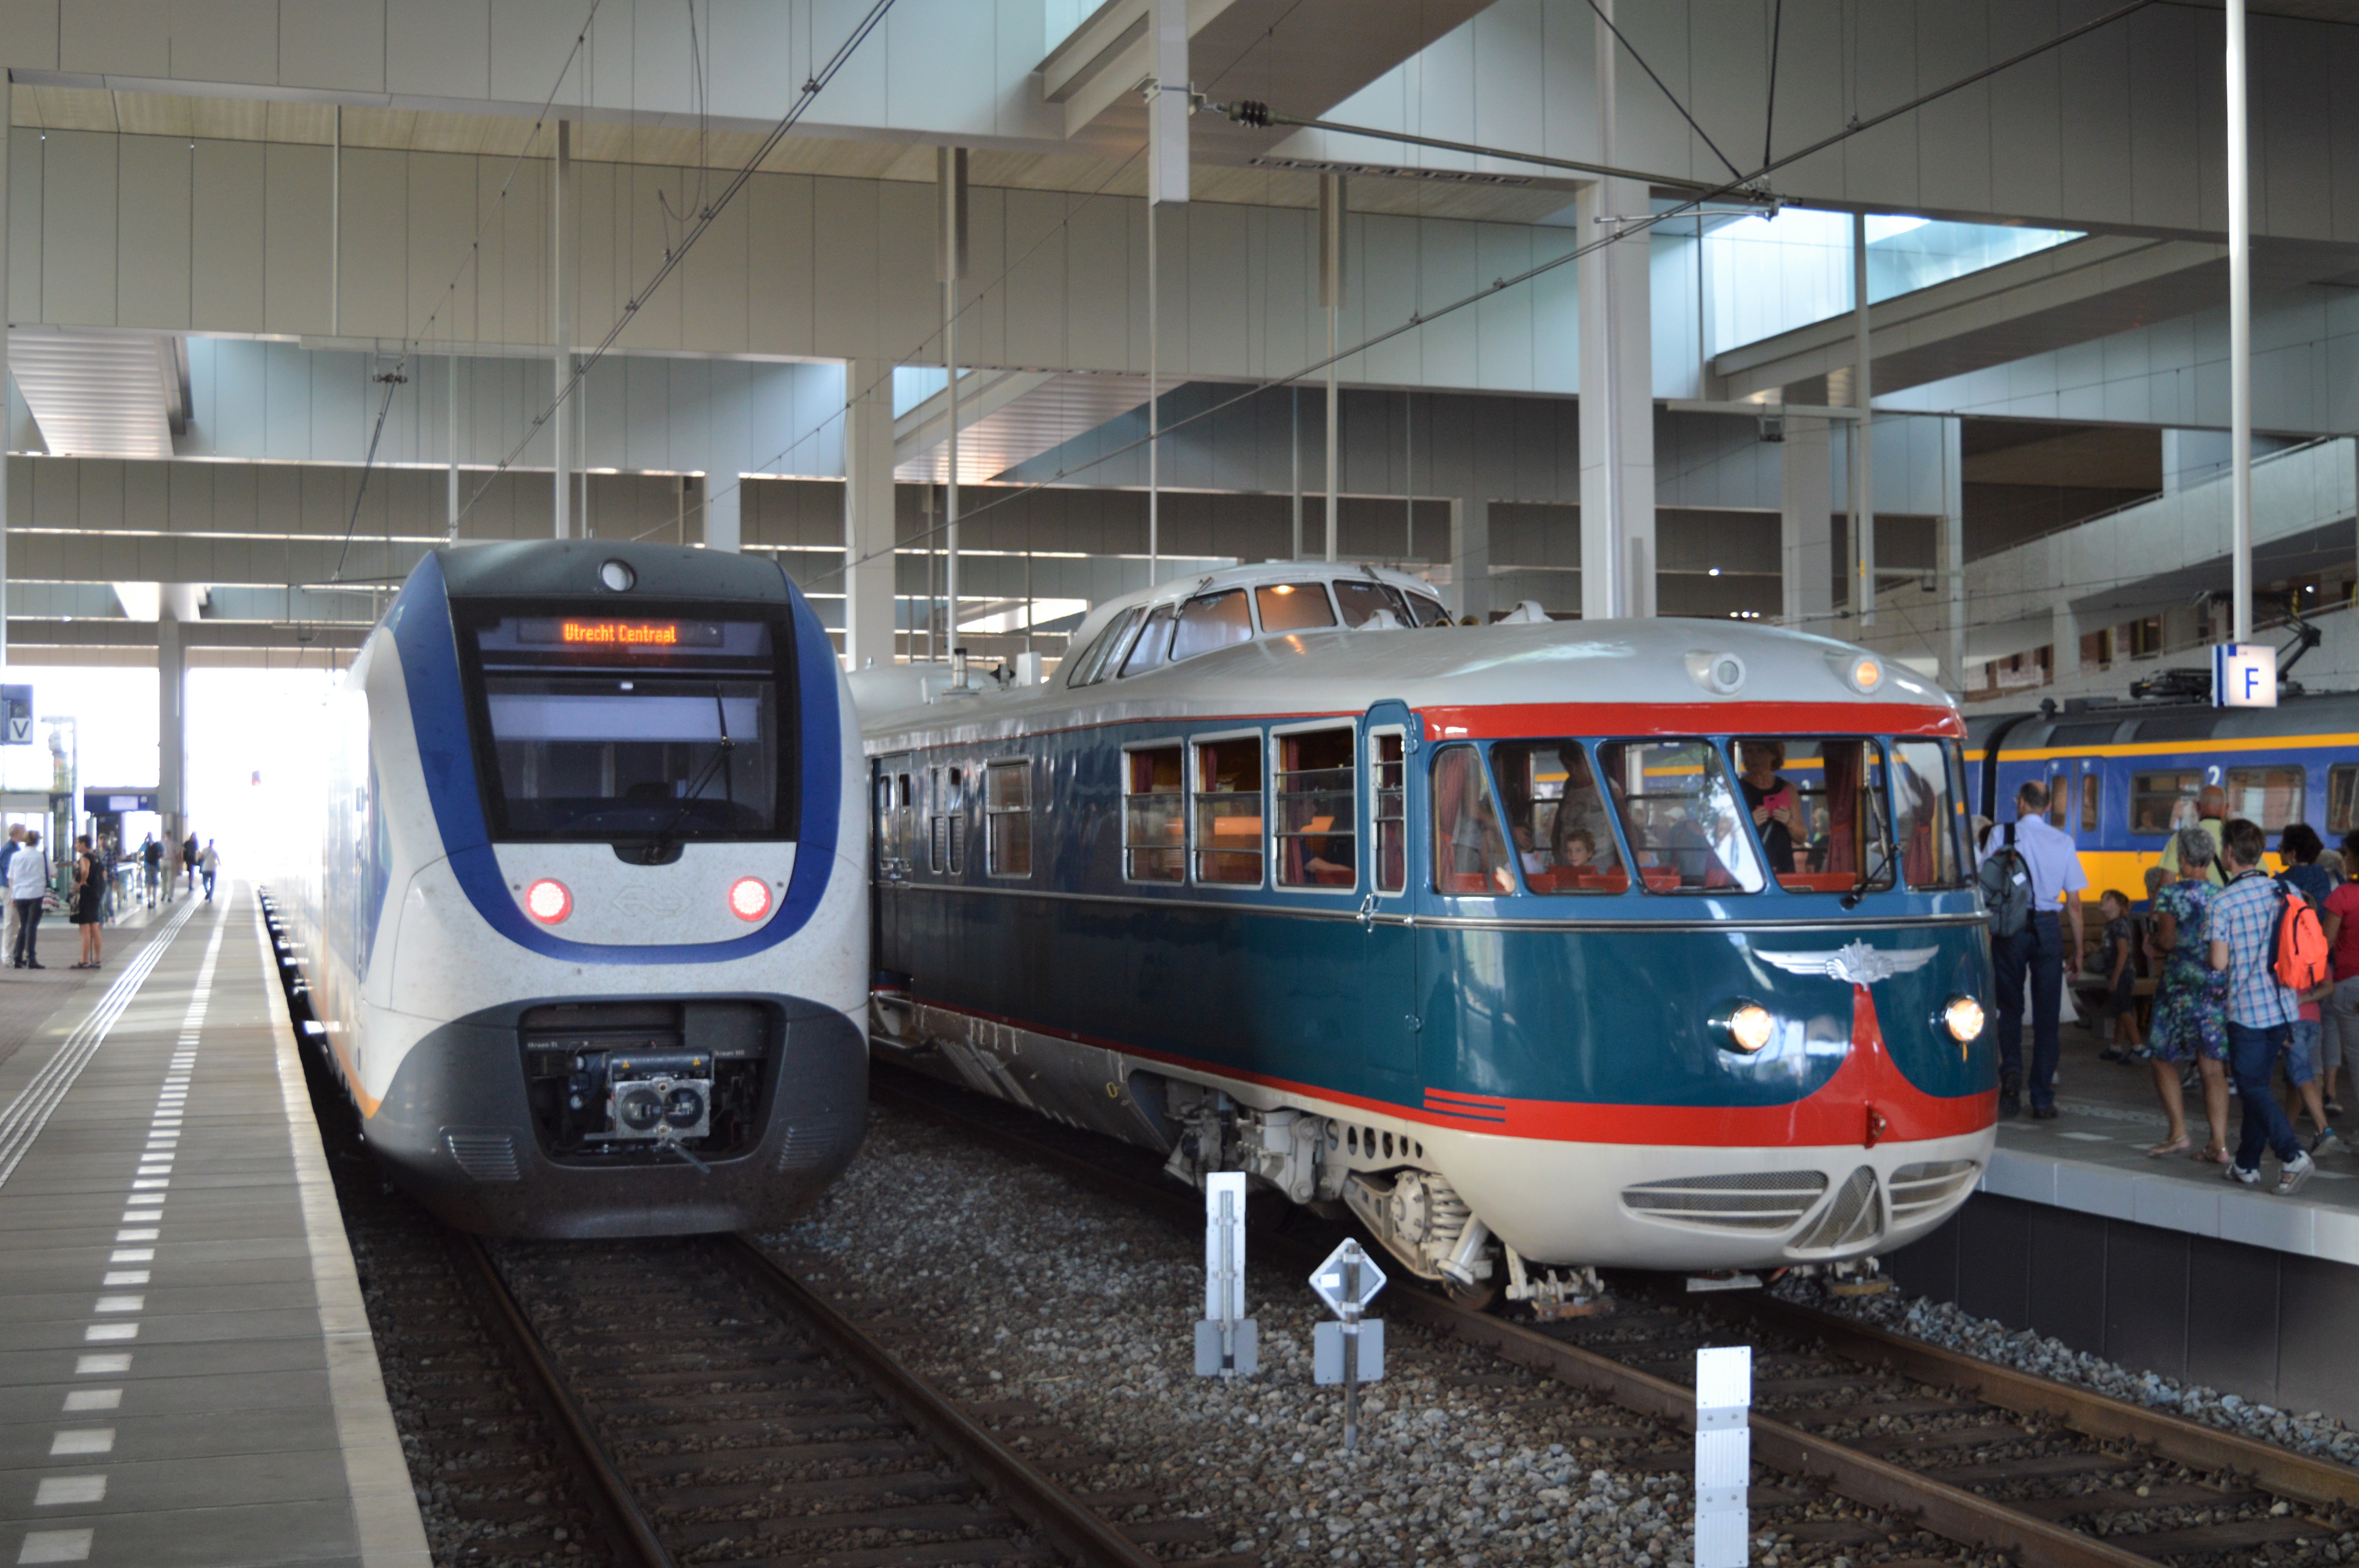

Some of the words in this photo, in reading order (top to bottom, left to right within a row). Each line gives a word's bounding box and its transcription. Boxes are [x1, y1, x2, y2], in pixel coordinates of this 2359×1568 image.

[564, 624, 615, 641] Utrecht
[618, 624, 676, 643] Centraal
[2245, 668, 2258, 699] F
[12, 720, 29, 738] V
[2208, 765, 2220, 786] 2
